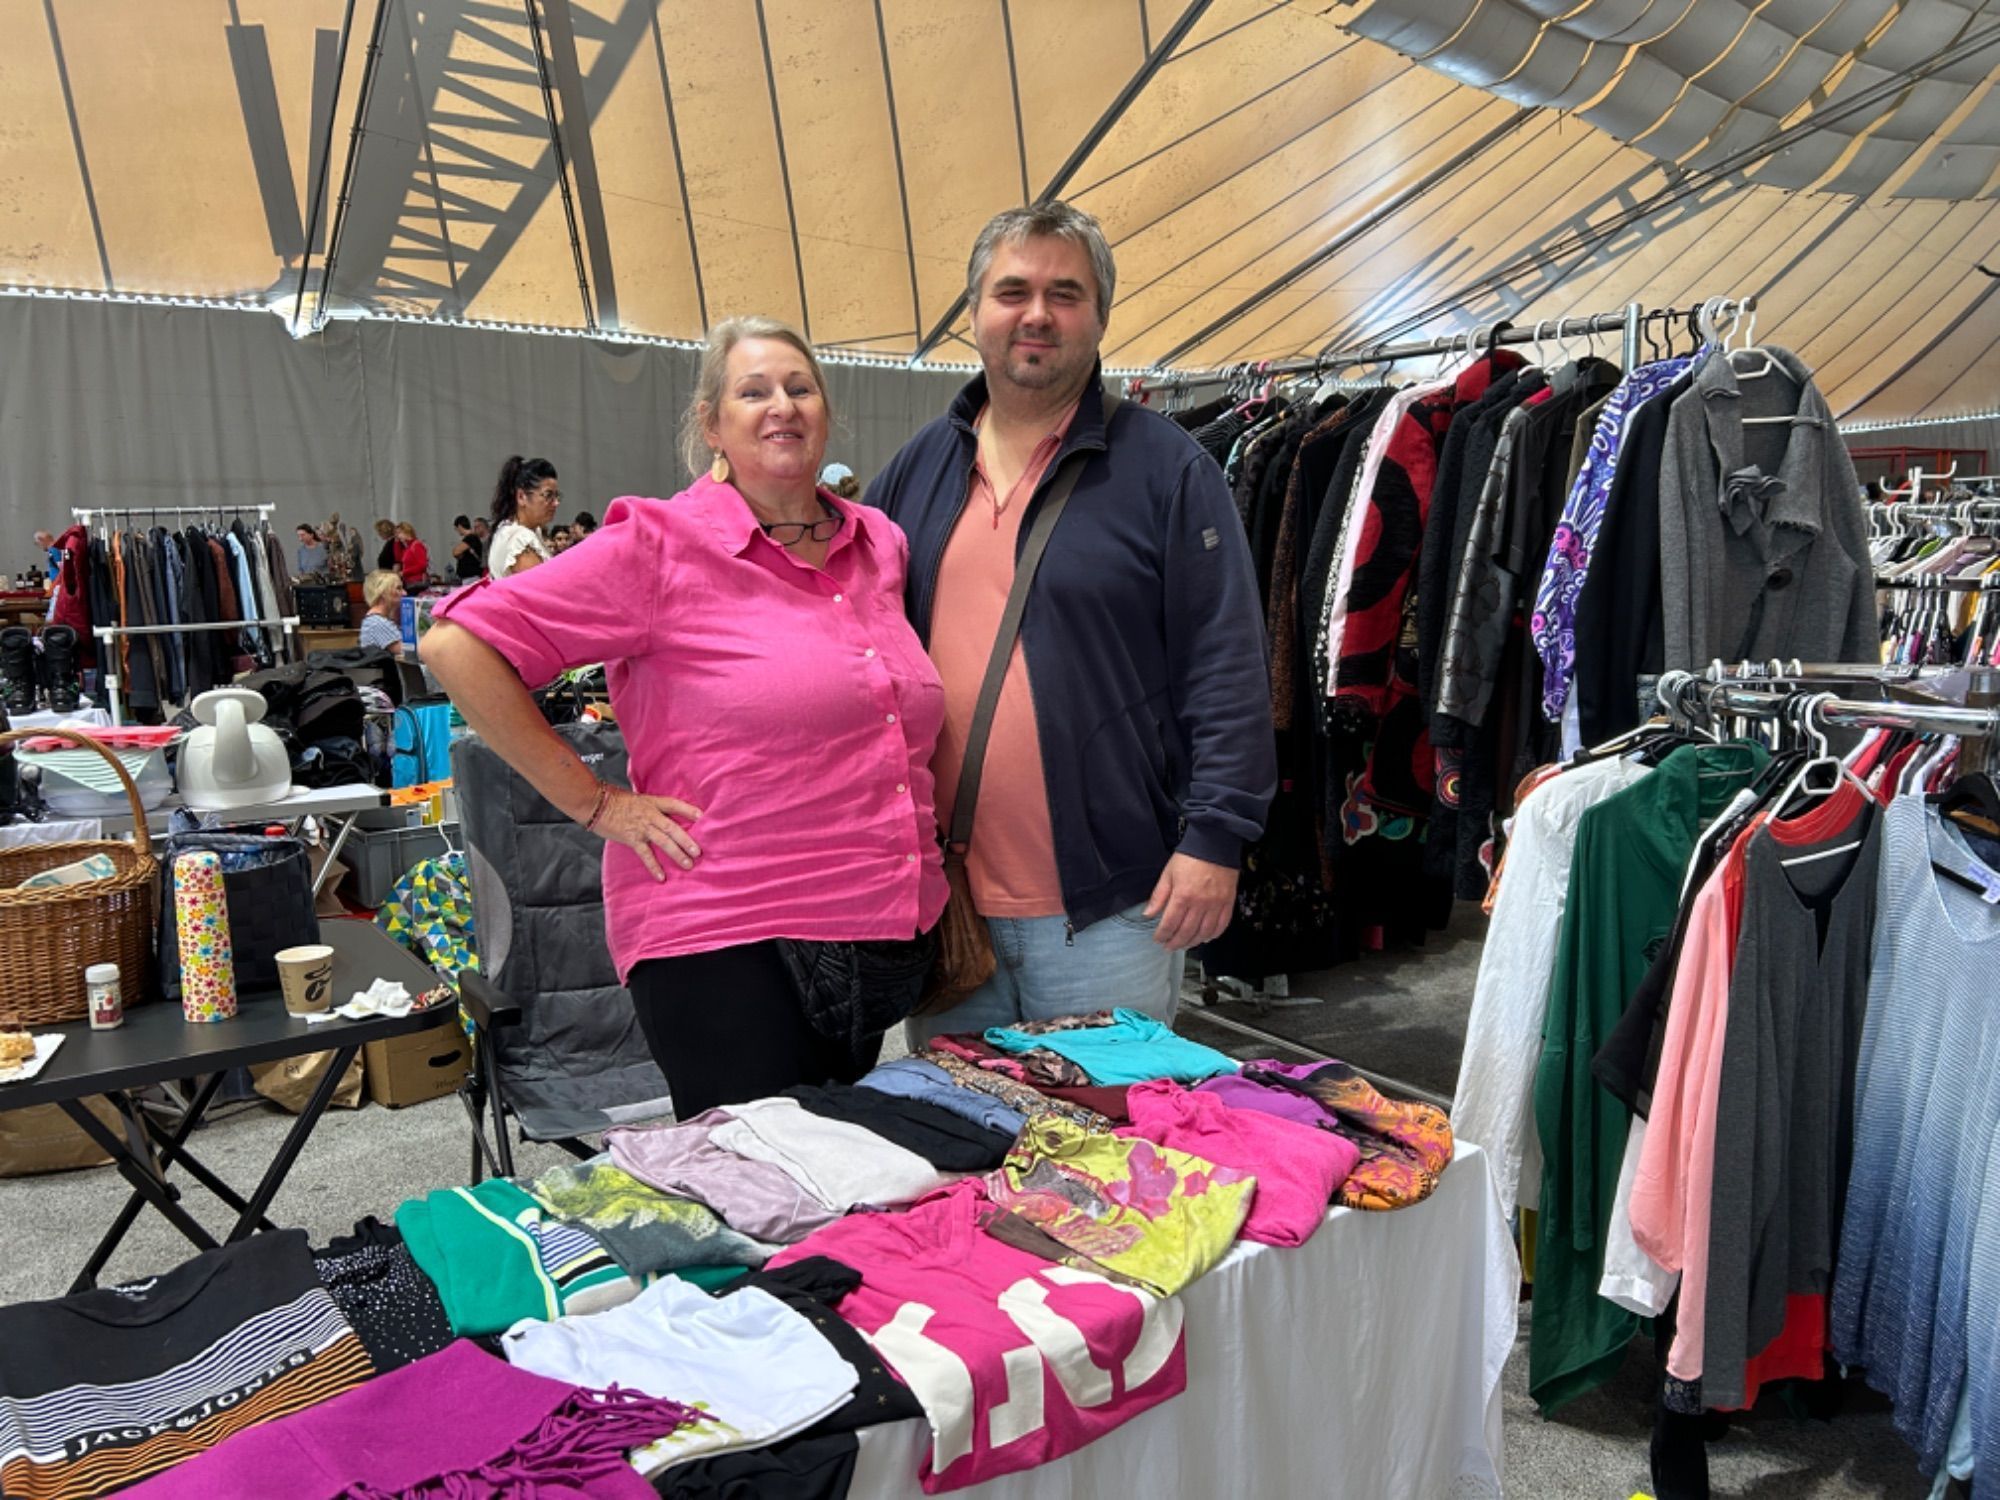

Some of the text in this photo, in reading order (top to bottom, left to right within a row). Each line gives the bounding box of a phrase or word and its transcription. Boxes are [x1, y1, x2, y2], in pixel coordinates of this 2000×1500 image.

[75, 1352, 307, 1456] JACK & JONES
